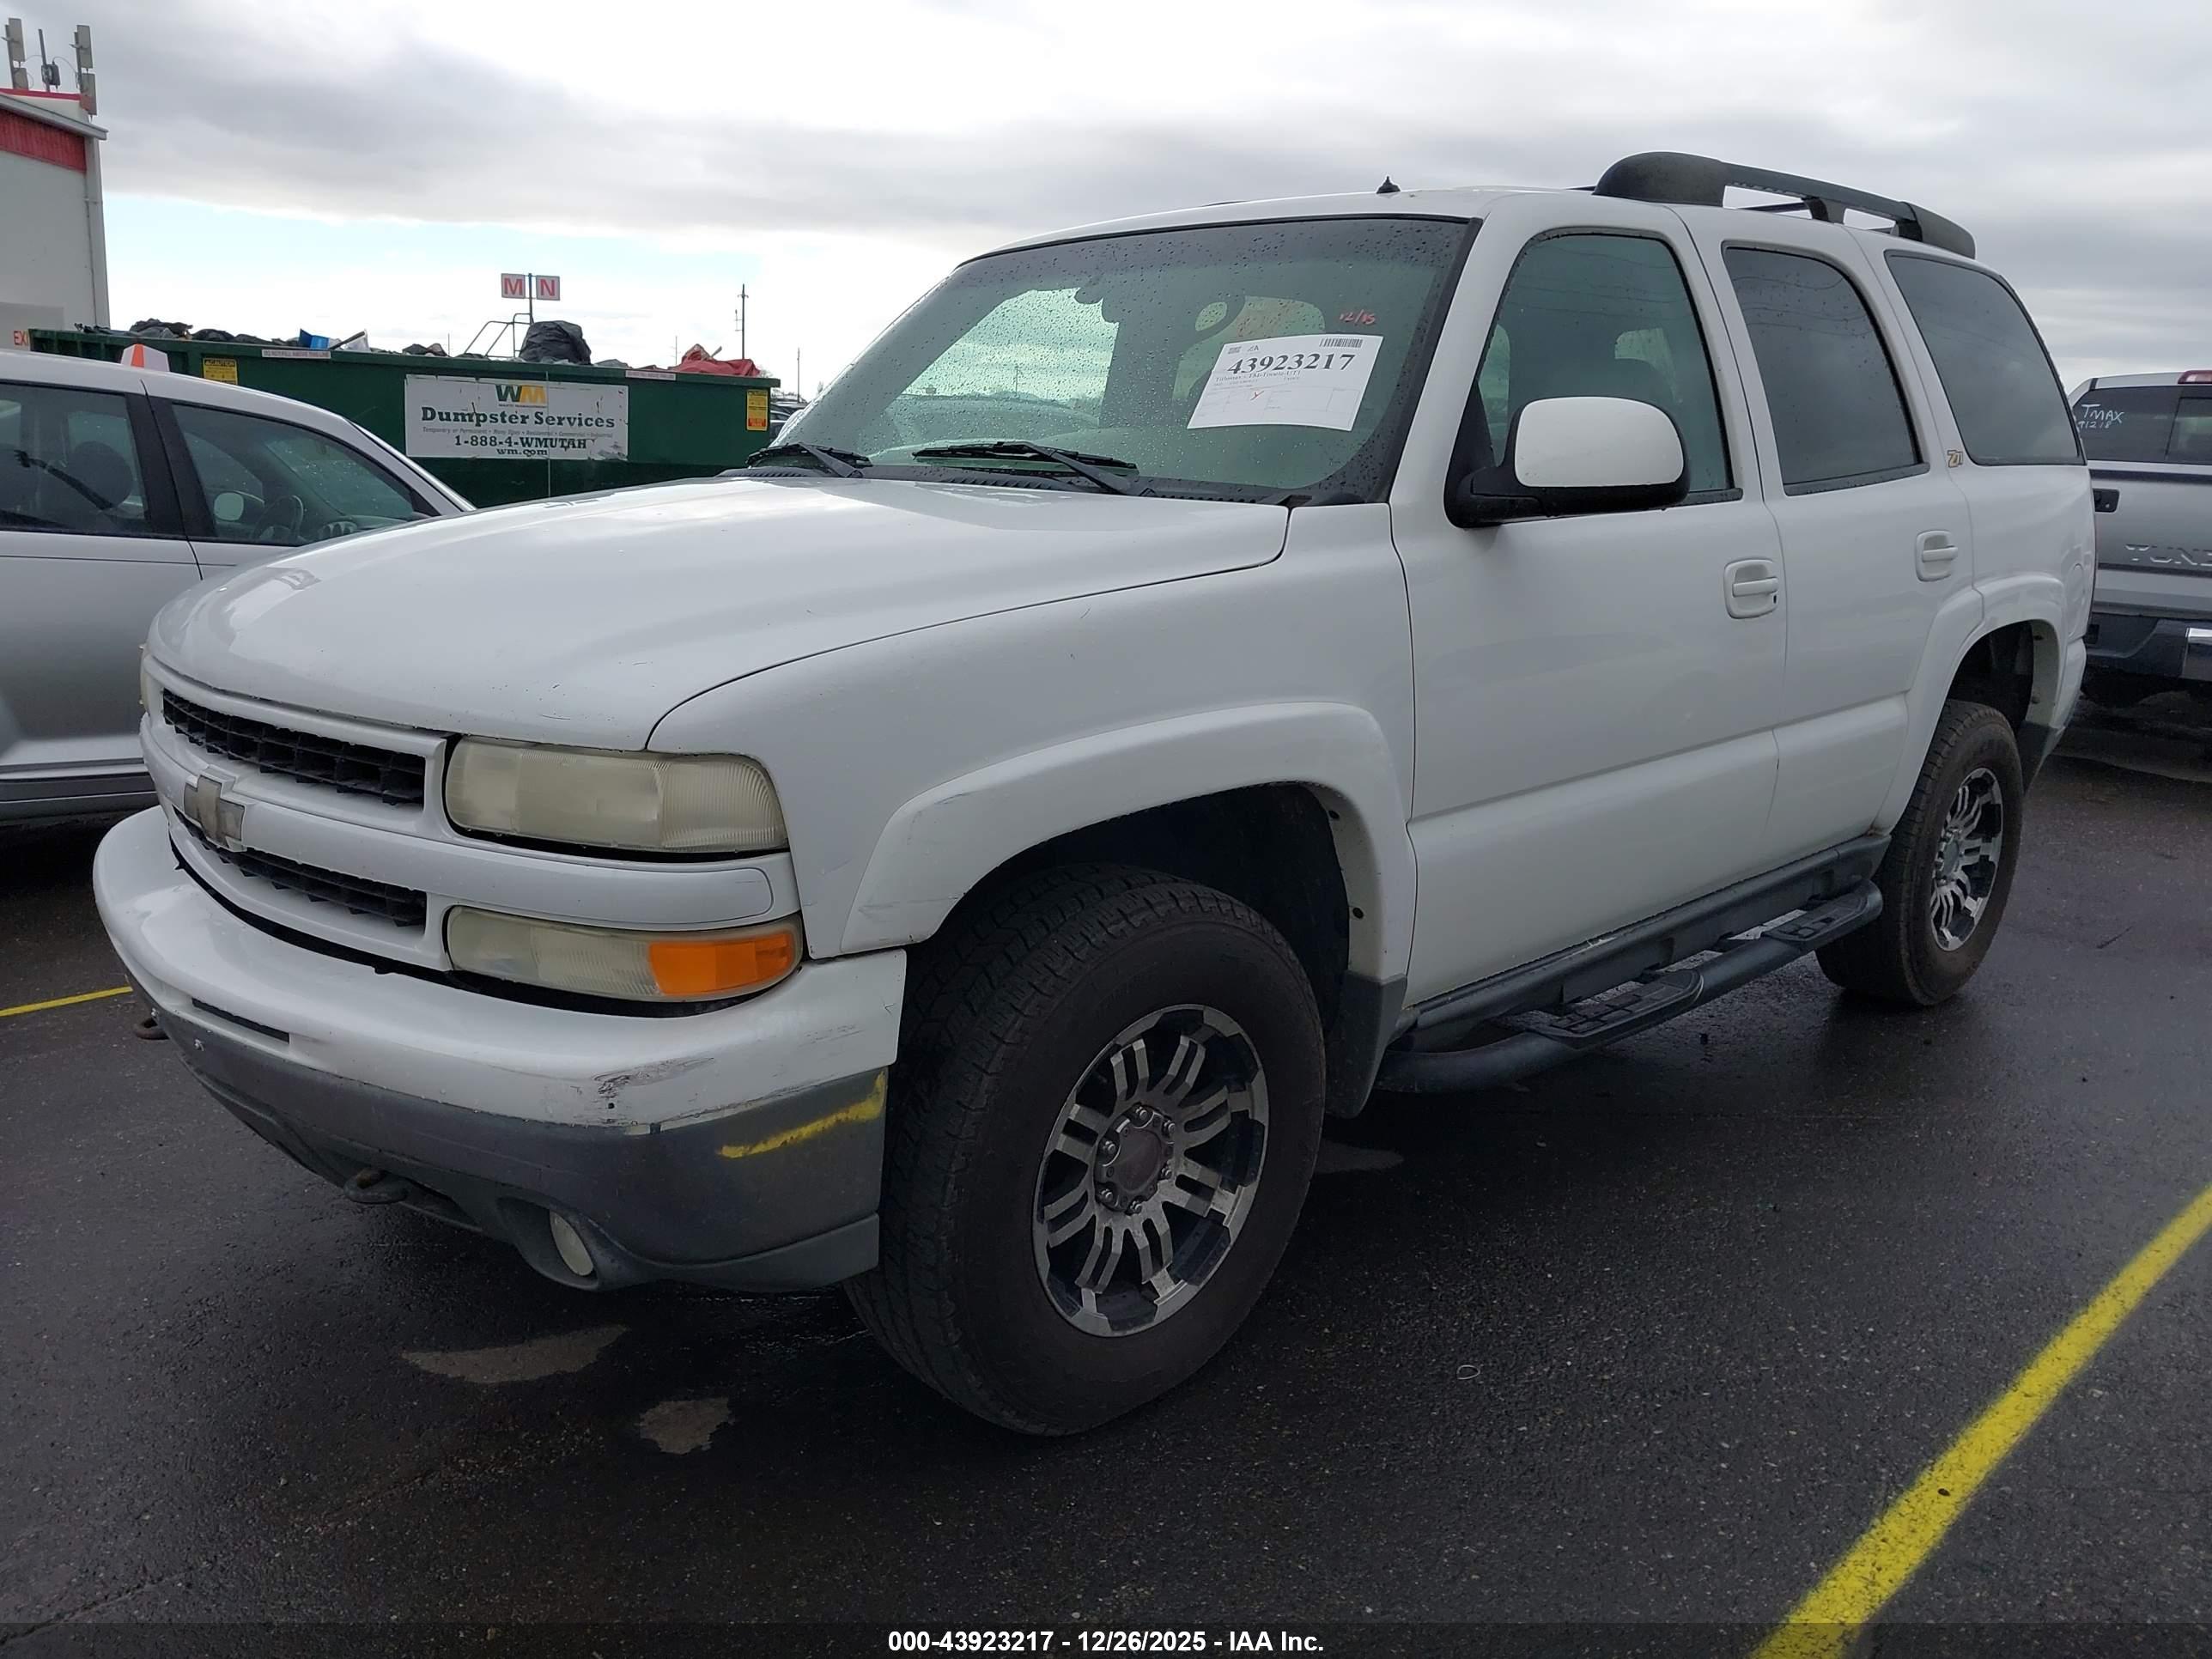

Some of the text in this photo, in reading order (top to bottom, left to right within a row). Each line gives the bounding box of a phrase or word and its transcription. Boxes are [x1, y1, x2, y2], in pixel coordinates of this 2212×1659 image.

[503, 277, 523, 295] M
[539, 278, 556, 296] N
[1227, 353, 1356, 374] 43923217
[495, 384, 547, 404] WM
[422, 407, 616, 428] Dumpster Services
[454, 434, 587, 449] 1-888-4-WMUTAH
